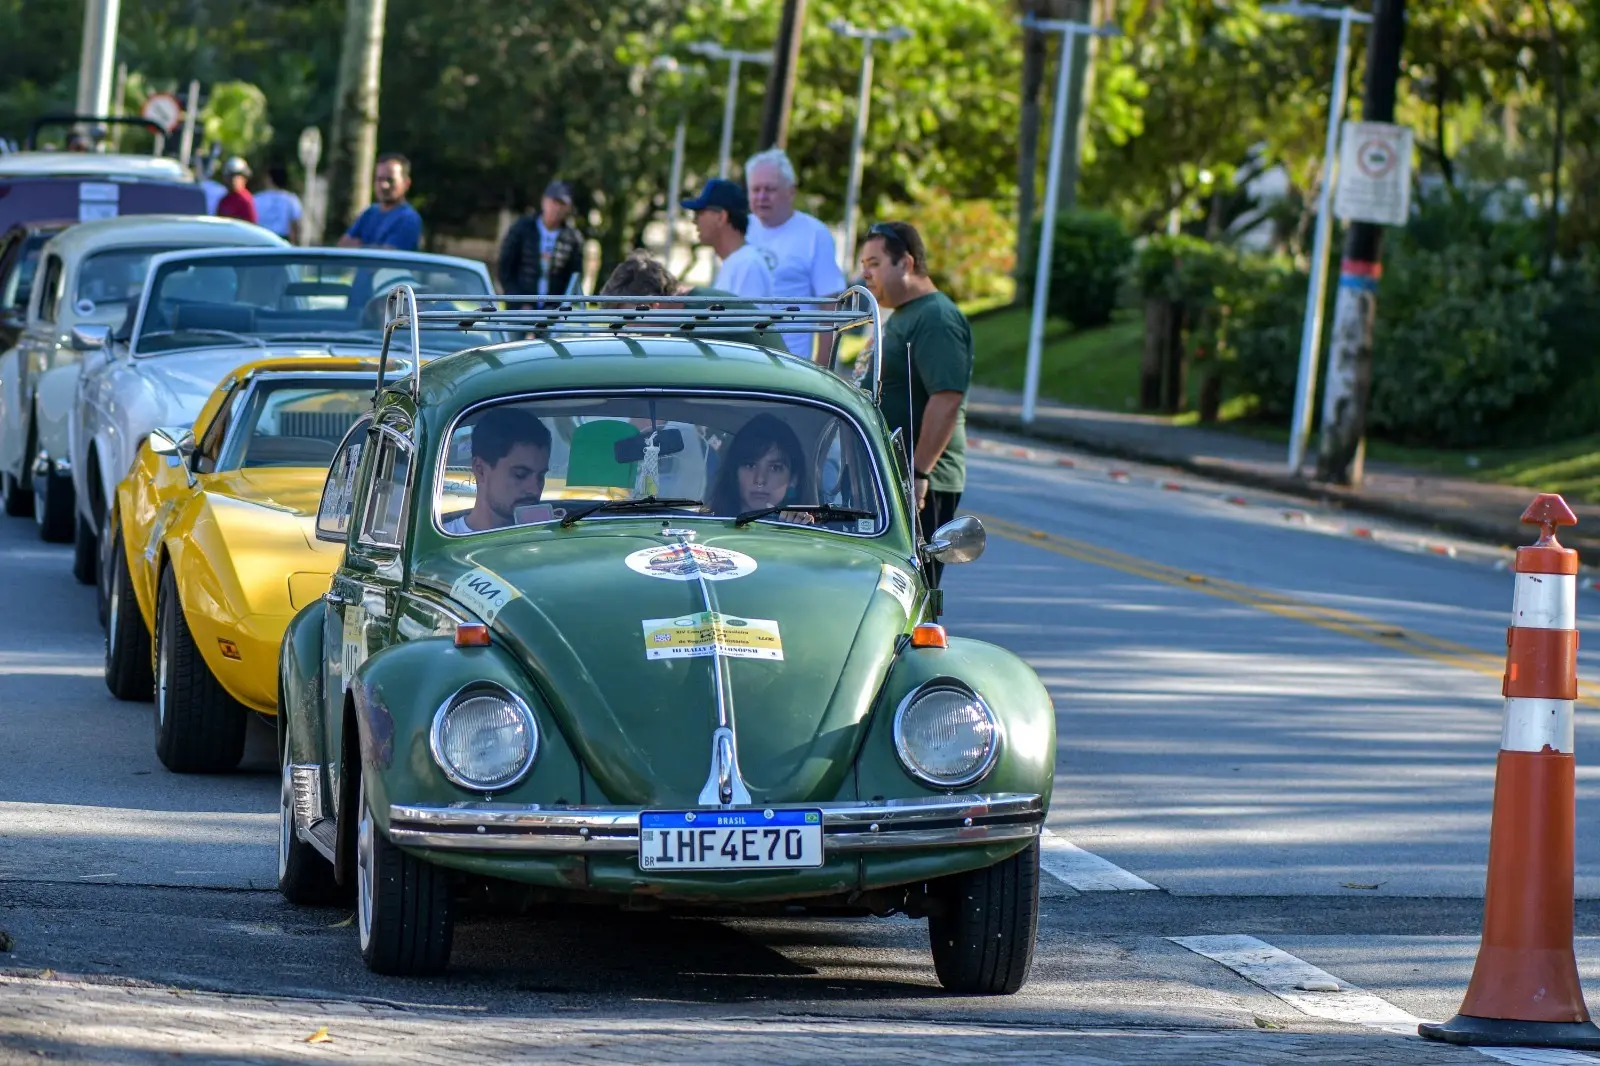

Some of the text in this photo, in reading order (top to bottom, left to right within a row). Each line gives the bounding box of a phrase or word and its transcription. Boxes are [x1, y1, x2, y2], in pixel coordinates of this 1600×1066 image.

[467, 577, 502, 600] KIA
[717, 817, 747, 825] BRASIL
[656, 829, 803, 863] IHF4E70
[644, 856, 655, 867] BR
